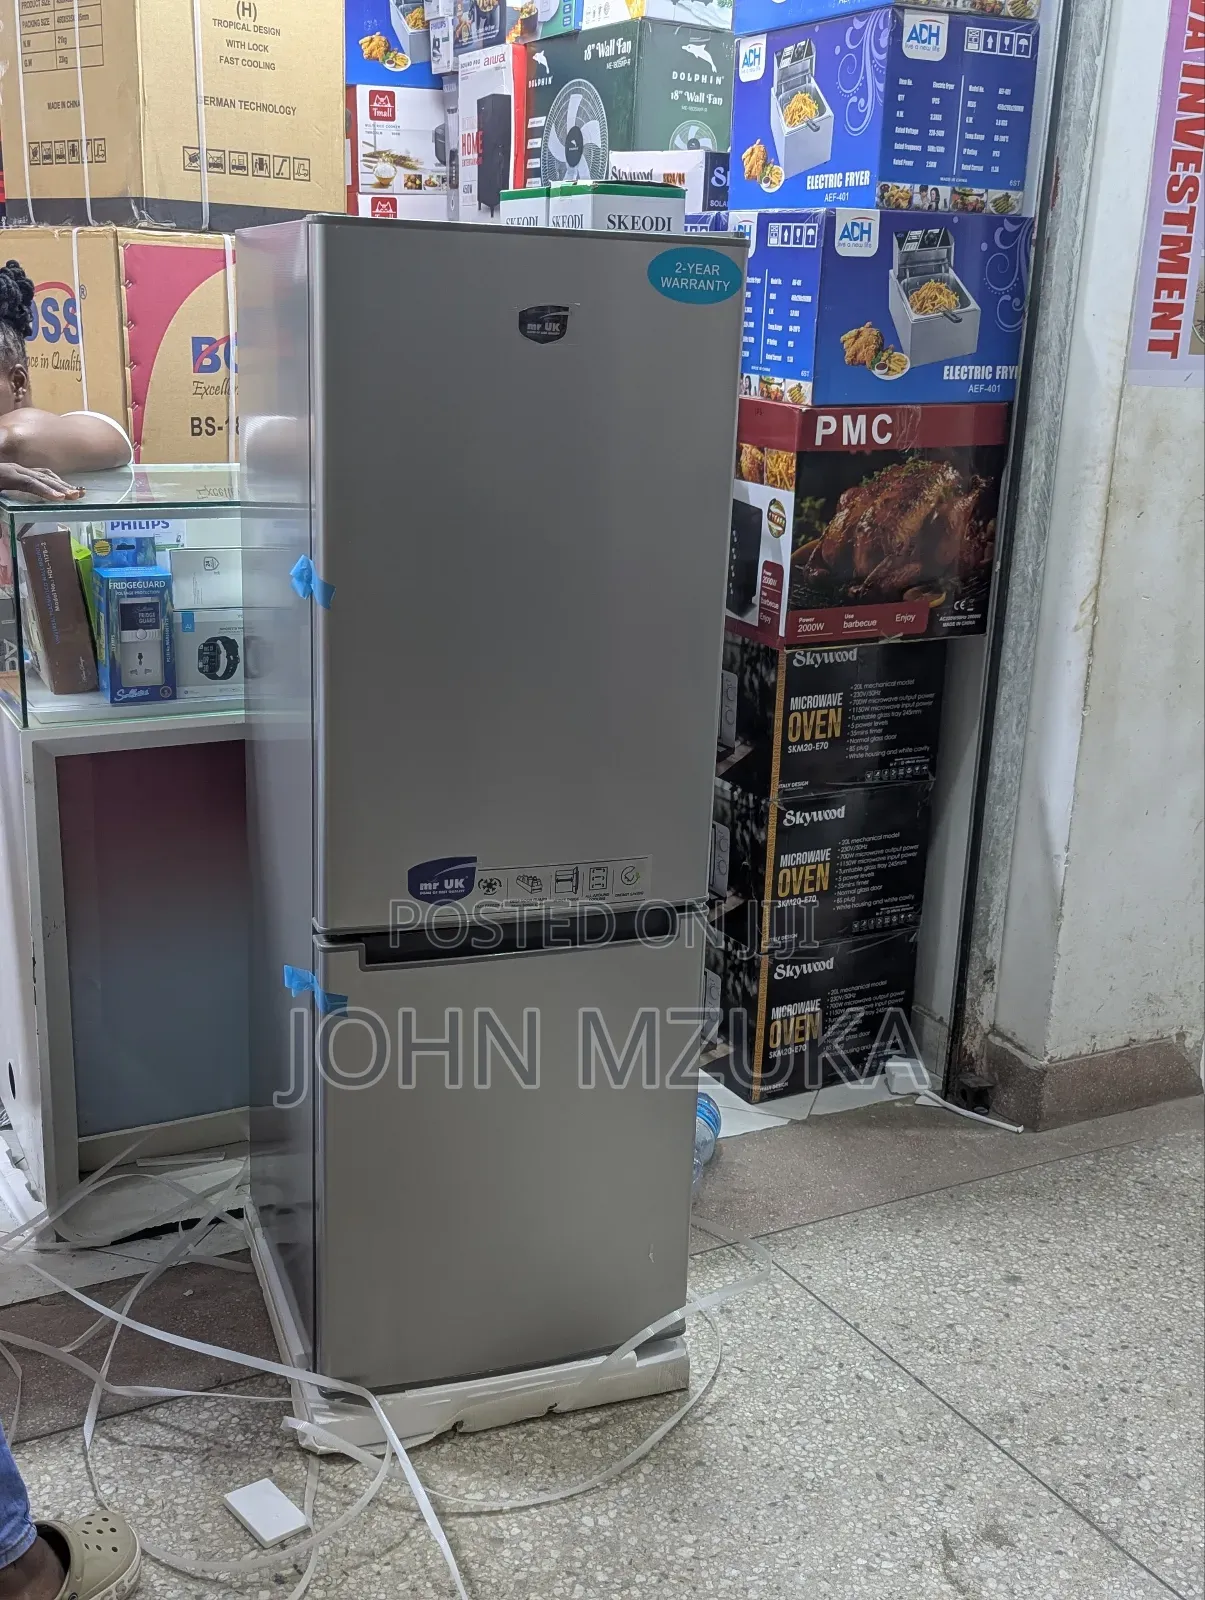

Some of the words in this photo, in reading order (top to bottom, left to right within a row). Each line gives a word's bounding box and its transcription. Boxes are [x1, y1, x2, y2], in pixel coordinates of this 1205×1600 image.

[236, 0, 258, 22] (H)
[22, 19, 41, 29] PACKING
[41, 17, 50, 26] SIZE
[212, 18, 251, 33] TROPICAL
[253, 24, 281, 37] DESIGN
[907, 24, 940, 46] ACH
[226, 39, 245, 51] WITH
[247, 40, 269, 53] LOCK
[597, 40, 615, 59] Wall
[616, 38, 631, 54] Fan
[219, 56, 240, 67] FAST
[242, 58, 276, 71] COOLING
[483, 52, 506, 67] aiwa
[741, 47, 762, 69] ACH
[528, 76, 552, 88] DOLPHIN
[672, 71, 722, 85] DOLPHIN
[684, 91, 705, 103] Wall
[706, 93, 723, 105] Fan
[47, 102, 60, 110] MADE
[61, 101, 66, 109] IN
[198, 95, 236, 109] ERMAN
[238, 99, 297, 116] TECHNOLOGY
[373, 108, 392, 118] Tmall
[462, 131, 483, 156] HOME
[806, 173, 844, 191] ELECTRIC
[845, 170, 870, 187] FRYER
[710, 199, 728, 208] SOLA
[824, 193, 849, 202] AEF-401
[1147, 61, 1205, 360] INVESTMENT
[552, 214, 584, 229] SKEODI
[606, 214, 672, 232] SKEODI
[839, 220, 872, 242] ACH
[675, 262, 720, 276] 2-YEAR
[660, 277, 731, 292] WARRANTY
[527, 322, 542, 331] mr
[544, 322, 561, 332] UK
[943, 365, 992, 380] ELECTRIC
[968, 383, 1001, 393] AEF-401
[814, 413, 893, 446] PMC
[110, 520, 170, 531] PHILIPS
[108, 580, 166, 590] FRIDGEGUARD
[51, 592, 61, 612] Model
[843, 619, 877, 629] barbecue
[895, 613, 916, 623] Enjoy
[797, 623, 825, 633] 2000W
[792, 648, 858, 668] Skywood
[864, 681, 896, 689] mechanical
[790, 692, 844, 711] MICROWAVE
[870, 704, 900, 712] microwave
[901, 701, 915, 709] input
[916, 700, 934, 708] power
[788, 708, 842, 743] OVEN
[788, 742, 829, 754] SKM20-E70
[864, 750, 885, 758] housing
[791, 780, 809, 788] DESIGN
[783, 805, 846, 827] Skywood
[851, 834, 882, 844] mechanical
[780, 848, 831, 868] MICROWAVE
[855, 849, 884, 858] microwave
[885, 846, 902, 854] output
[420, 882, 439, 891] mr
[444, 879, 465, 889] UK
[777, 863, 830, 898] OVEN
[837, 888, 856, 896] Normal
[777, 895, 817, 908] SKM20-E70
[773, 957, 835, 980] Skywood
[771, 999, 821, 1020] MICROWAVE
[769, 1012, 820, 1049] OVEN
[768, 1045, 807, 1059] SKM20-E70
